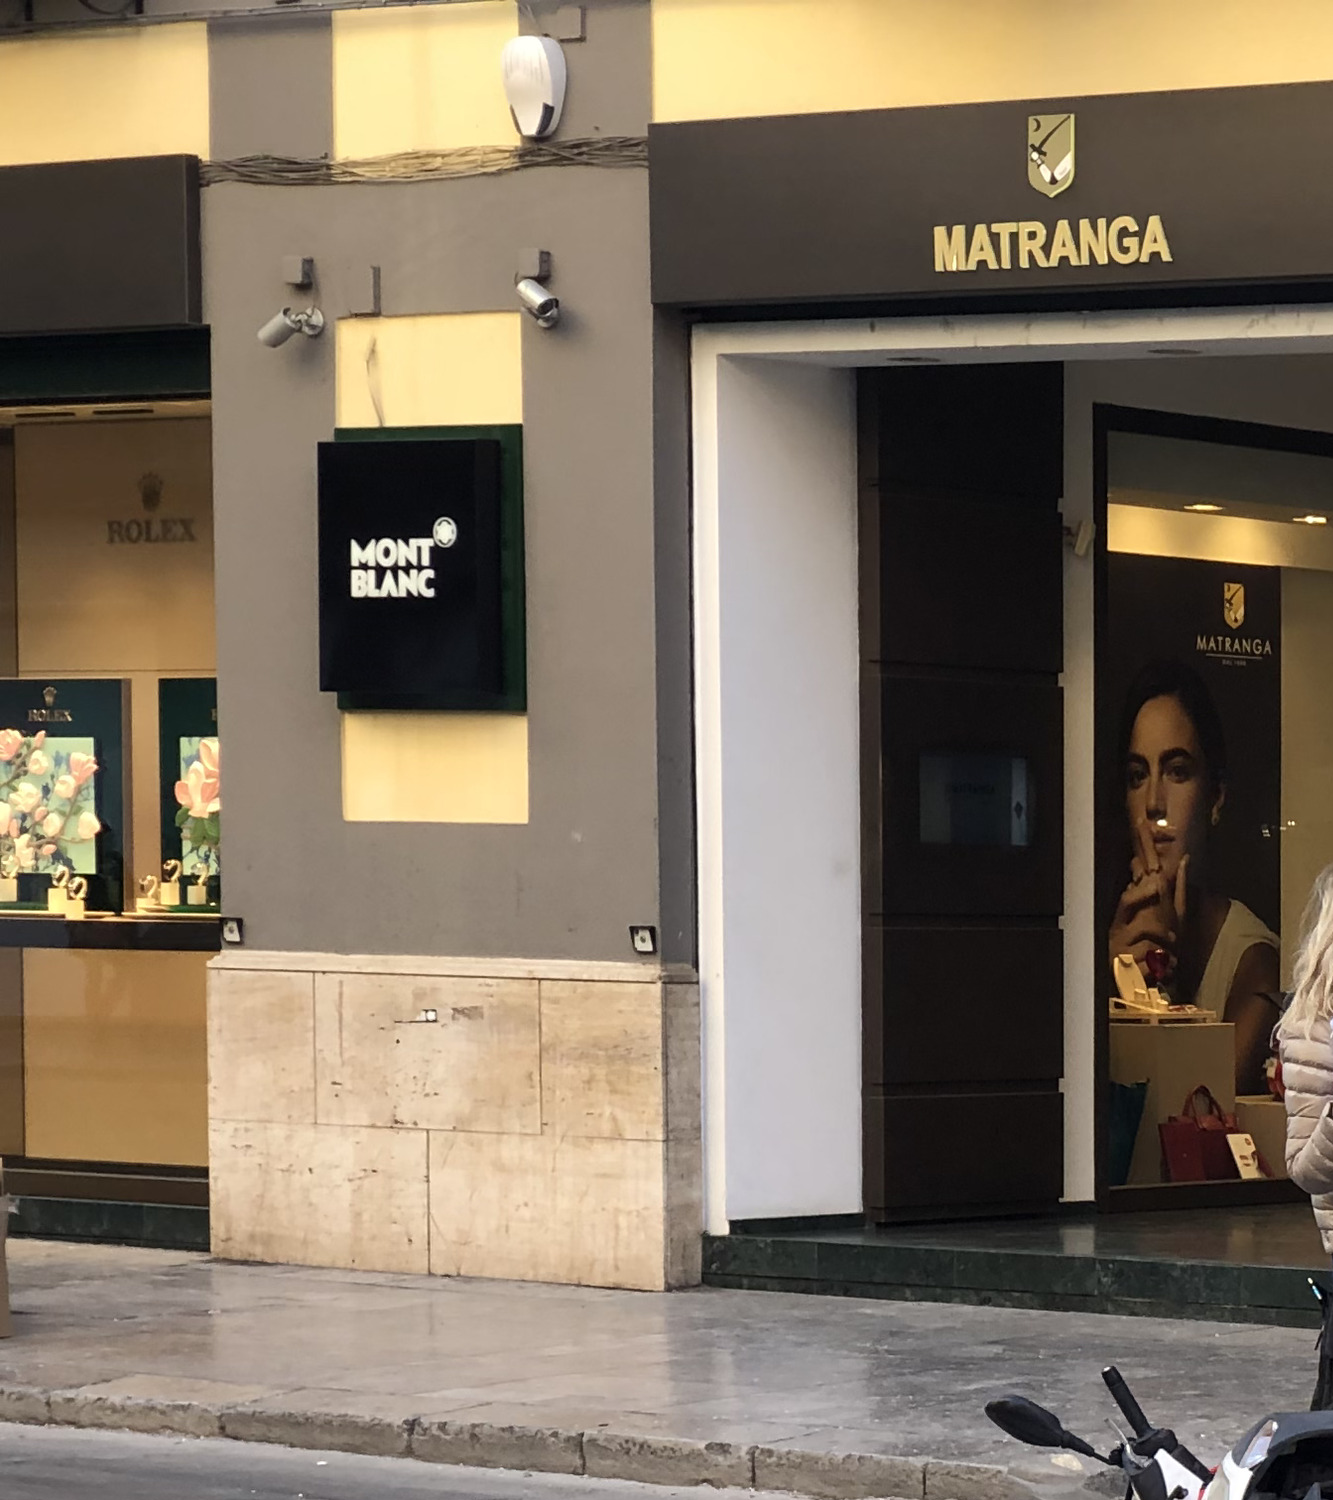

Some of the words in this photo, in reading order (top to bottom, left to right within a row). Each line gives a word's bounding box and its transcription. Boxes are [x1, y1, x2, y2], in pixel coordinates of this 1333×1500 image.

[933, 215, 1173, 272] MATRANGA
[106, 518, 197, 544] ROLEX
[350, 538, 434, 567] MONT
[350, 568, 436, 598] BLANC
[1196, 634, 1272, 655] MATRANGA
[27, 709, 73, 722] ROLEX
